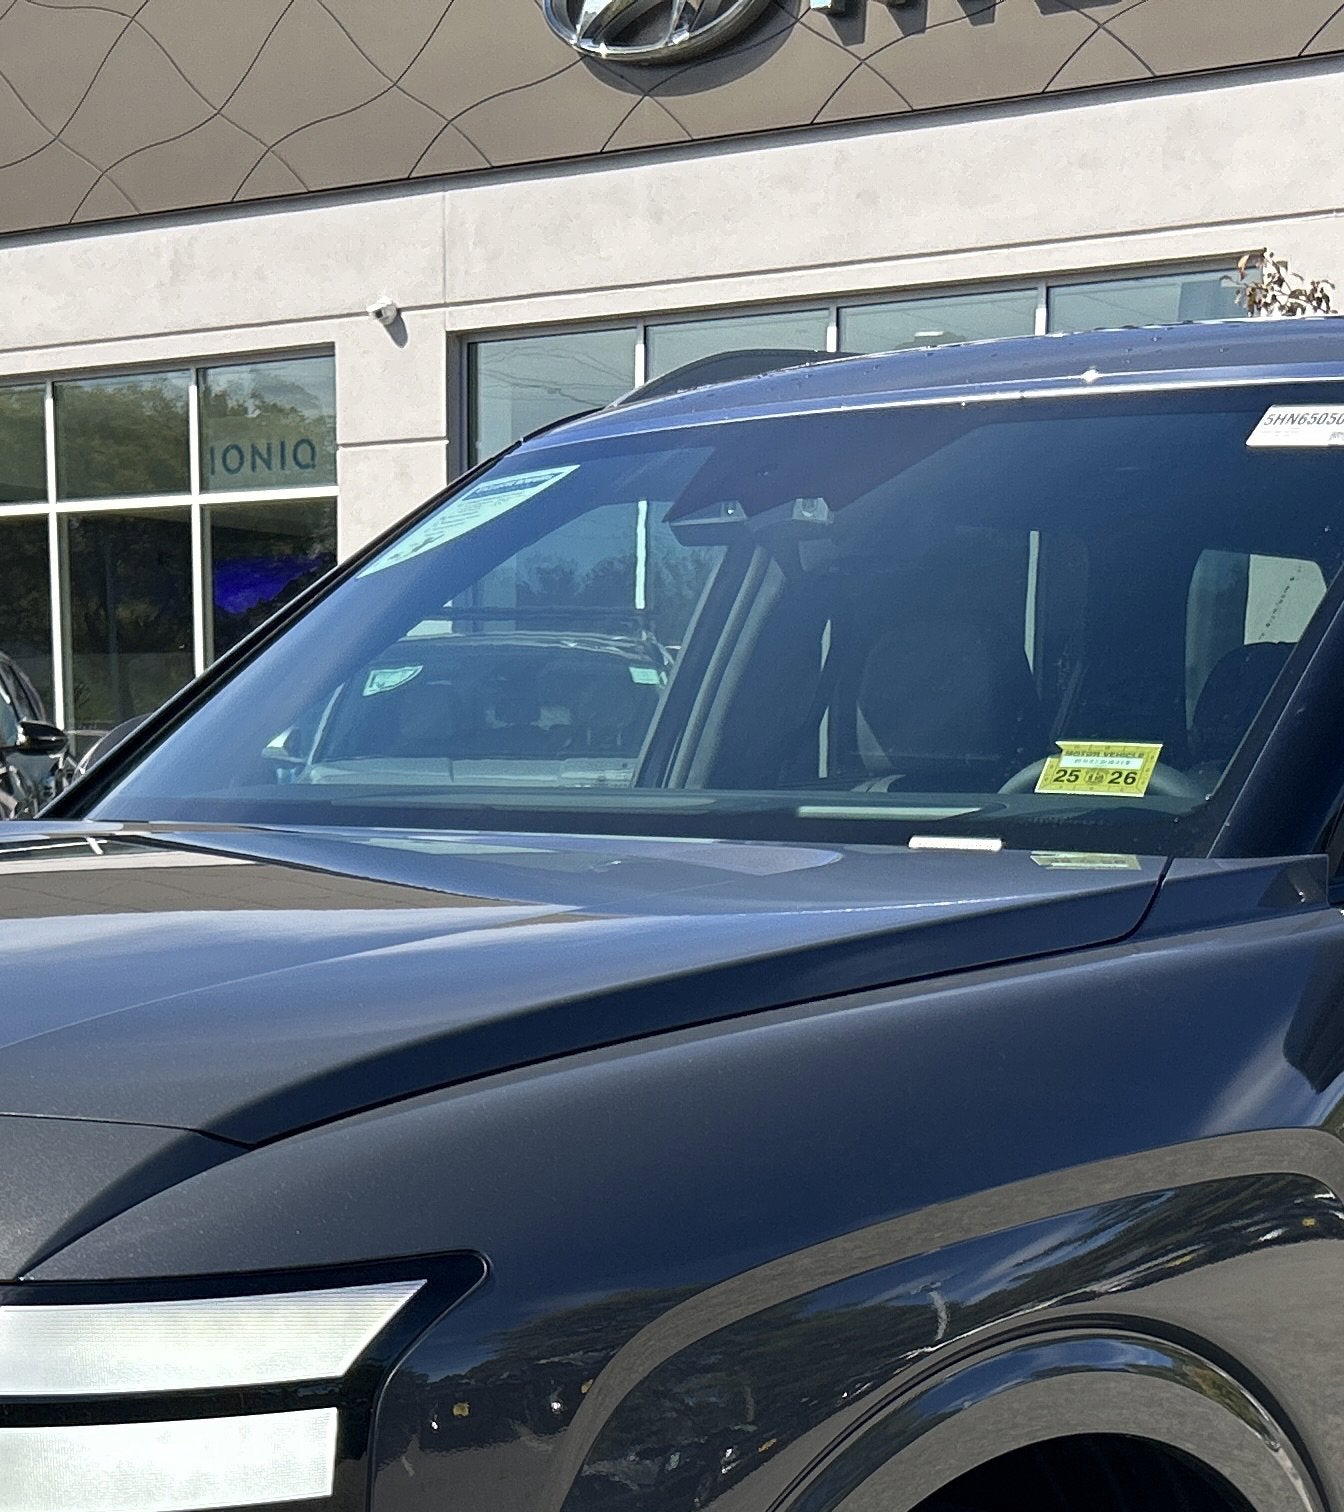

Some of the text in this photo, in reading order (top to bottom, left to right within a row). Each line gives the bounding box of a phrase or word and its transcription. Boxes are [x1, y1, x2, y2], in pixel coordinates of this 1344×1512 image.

[208, 437, 317, 476] IONIQ
[1053, 769, 1138, 786] 25 26
